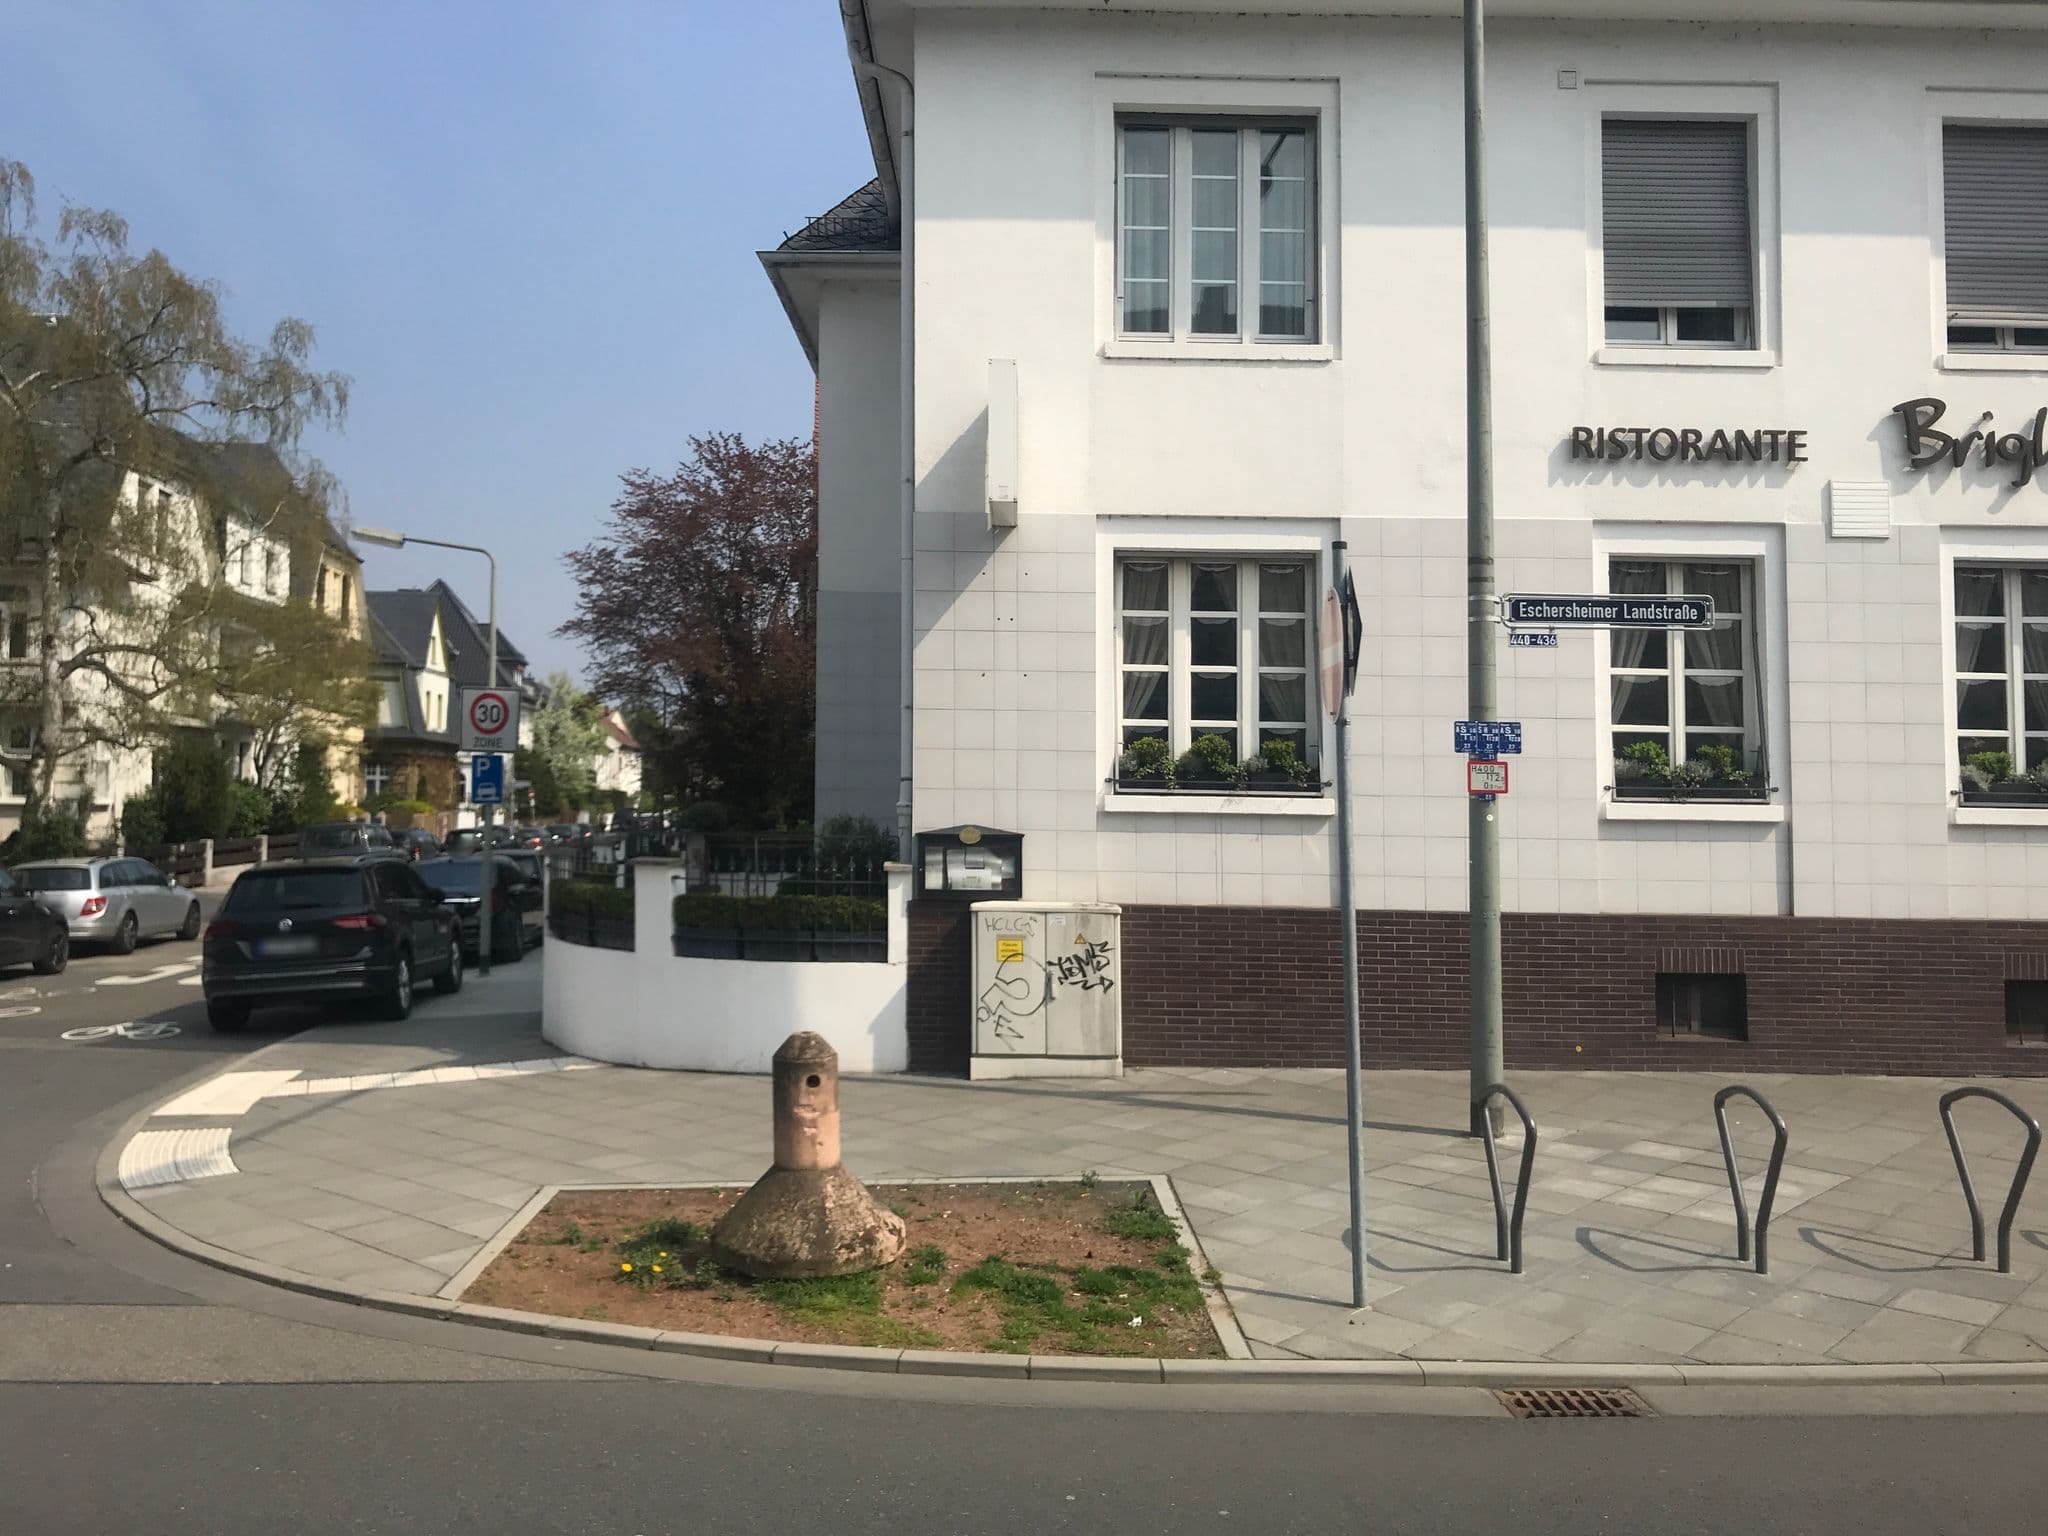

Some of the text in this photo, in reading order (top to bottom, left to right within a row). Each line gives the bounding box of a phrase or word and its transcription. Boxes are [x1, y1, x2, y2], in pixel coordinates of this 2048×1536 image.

[1571, 426, 1808, 462] RISTORANTE
[1519, 602, 1698, 620] Eschersheimer Landstraße
[1510, 634, 1557, 646] 440-436
[478, 704, 501, 723] 30
[473, 737, 502, 749] ZONE
[476, 757, 490, 777] P
